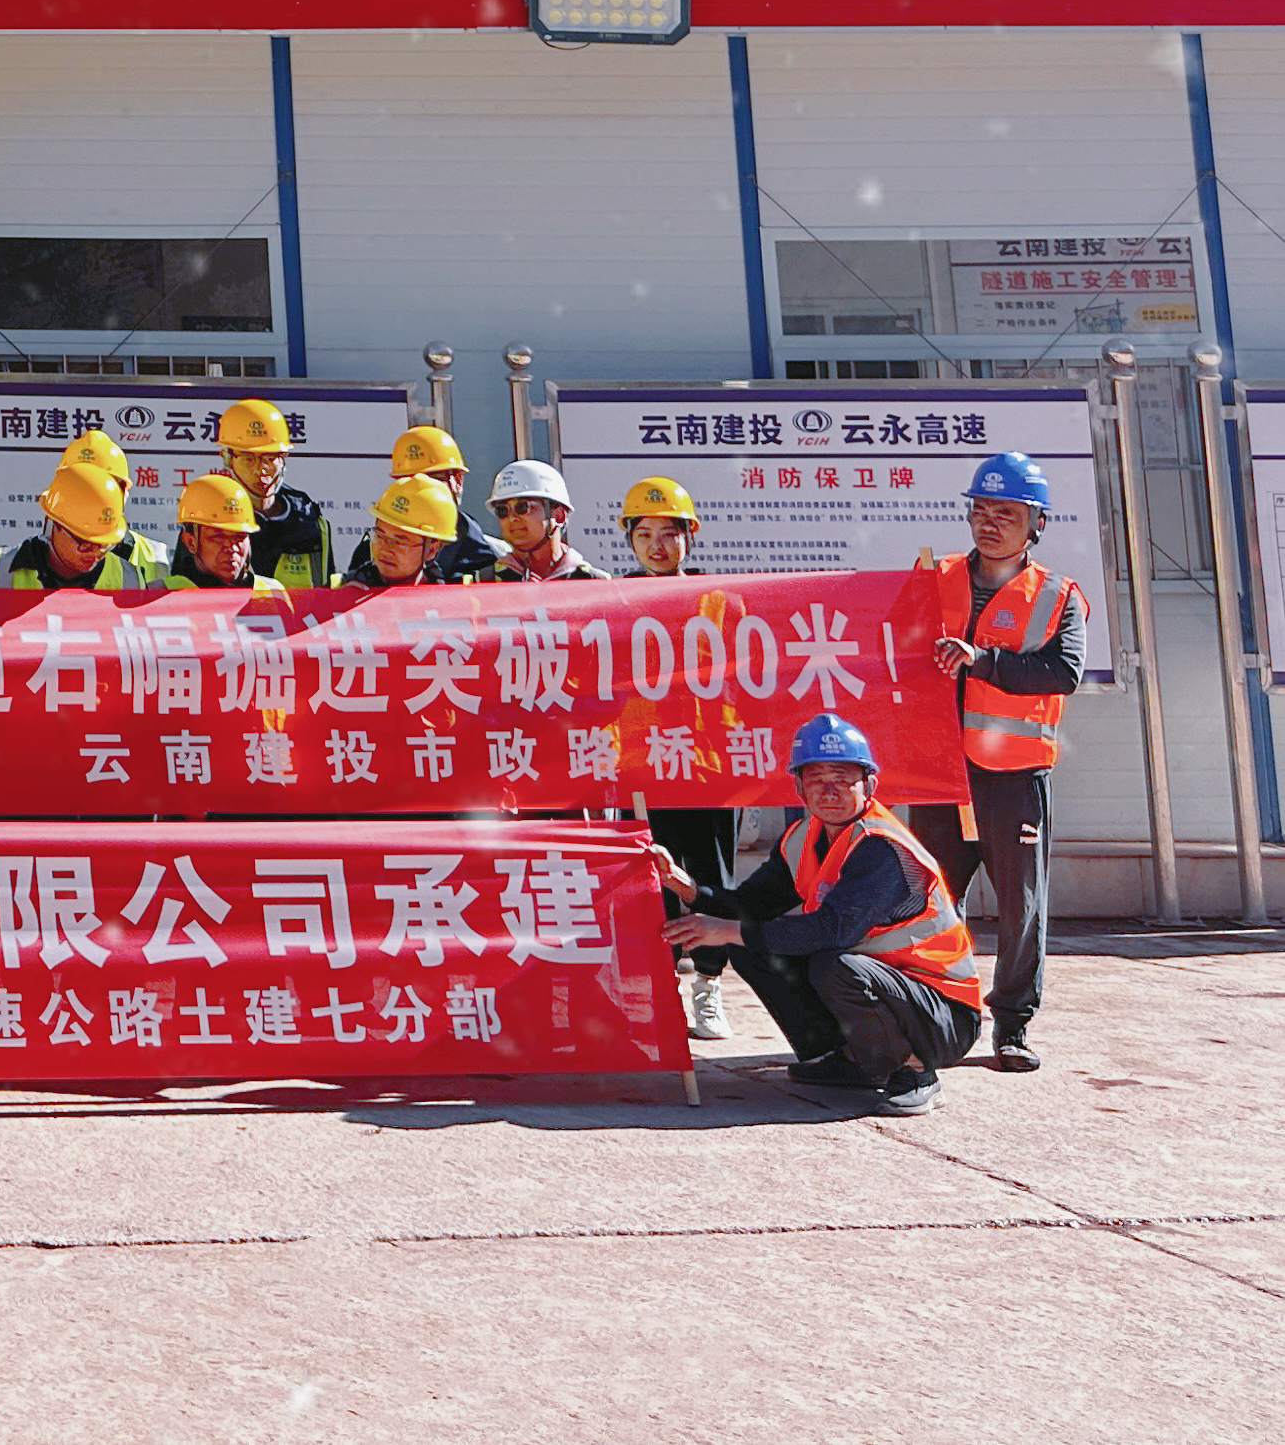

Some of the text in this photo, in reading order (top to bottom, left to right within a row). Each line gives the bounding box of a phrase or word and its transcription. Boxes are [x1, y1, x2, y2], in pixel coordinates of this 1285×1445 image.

[1156, 237, 1191, 256] 云
[118, 432, 153, 442] YCIH
[163, 410, 308, 444] 云永速
[638, 413, 988, 446] 云南建投 YCIH 云永高速
[740, 466, 916, 490] 消防保卫牌
[80, 725, 780, 785] 云南建投市政路桥部
